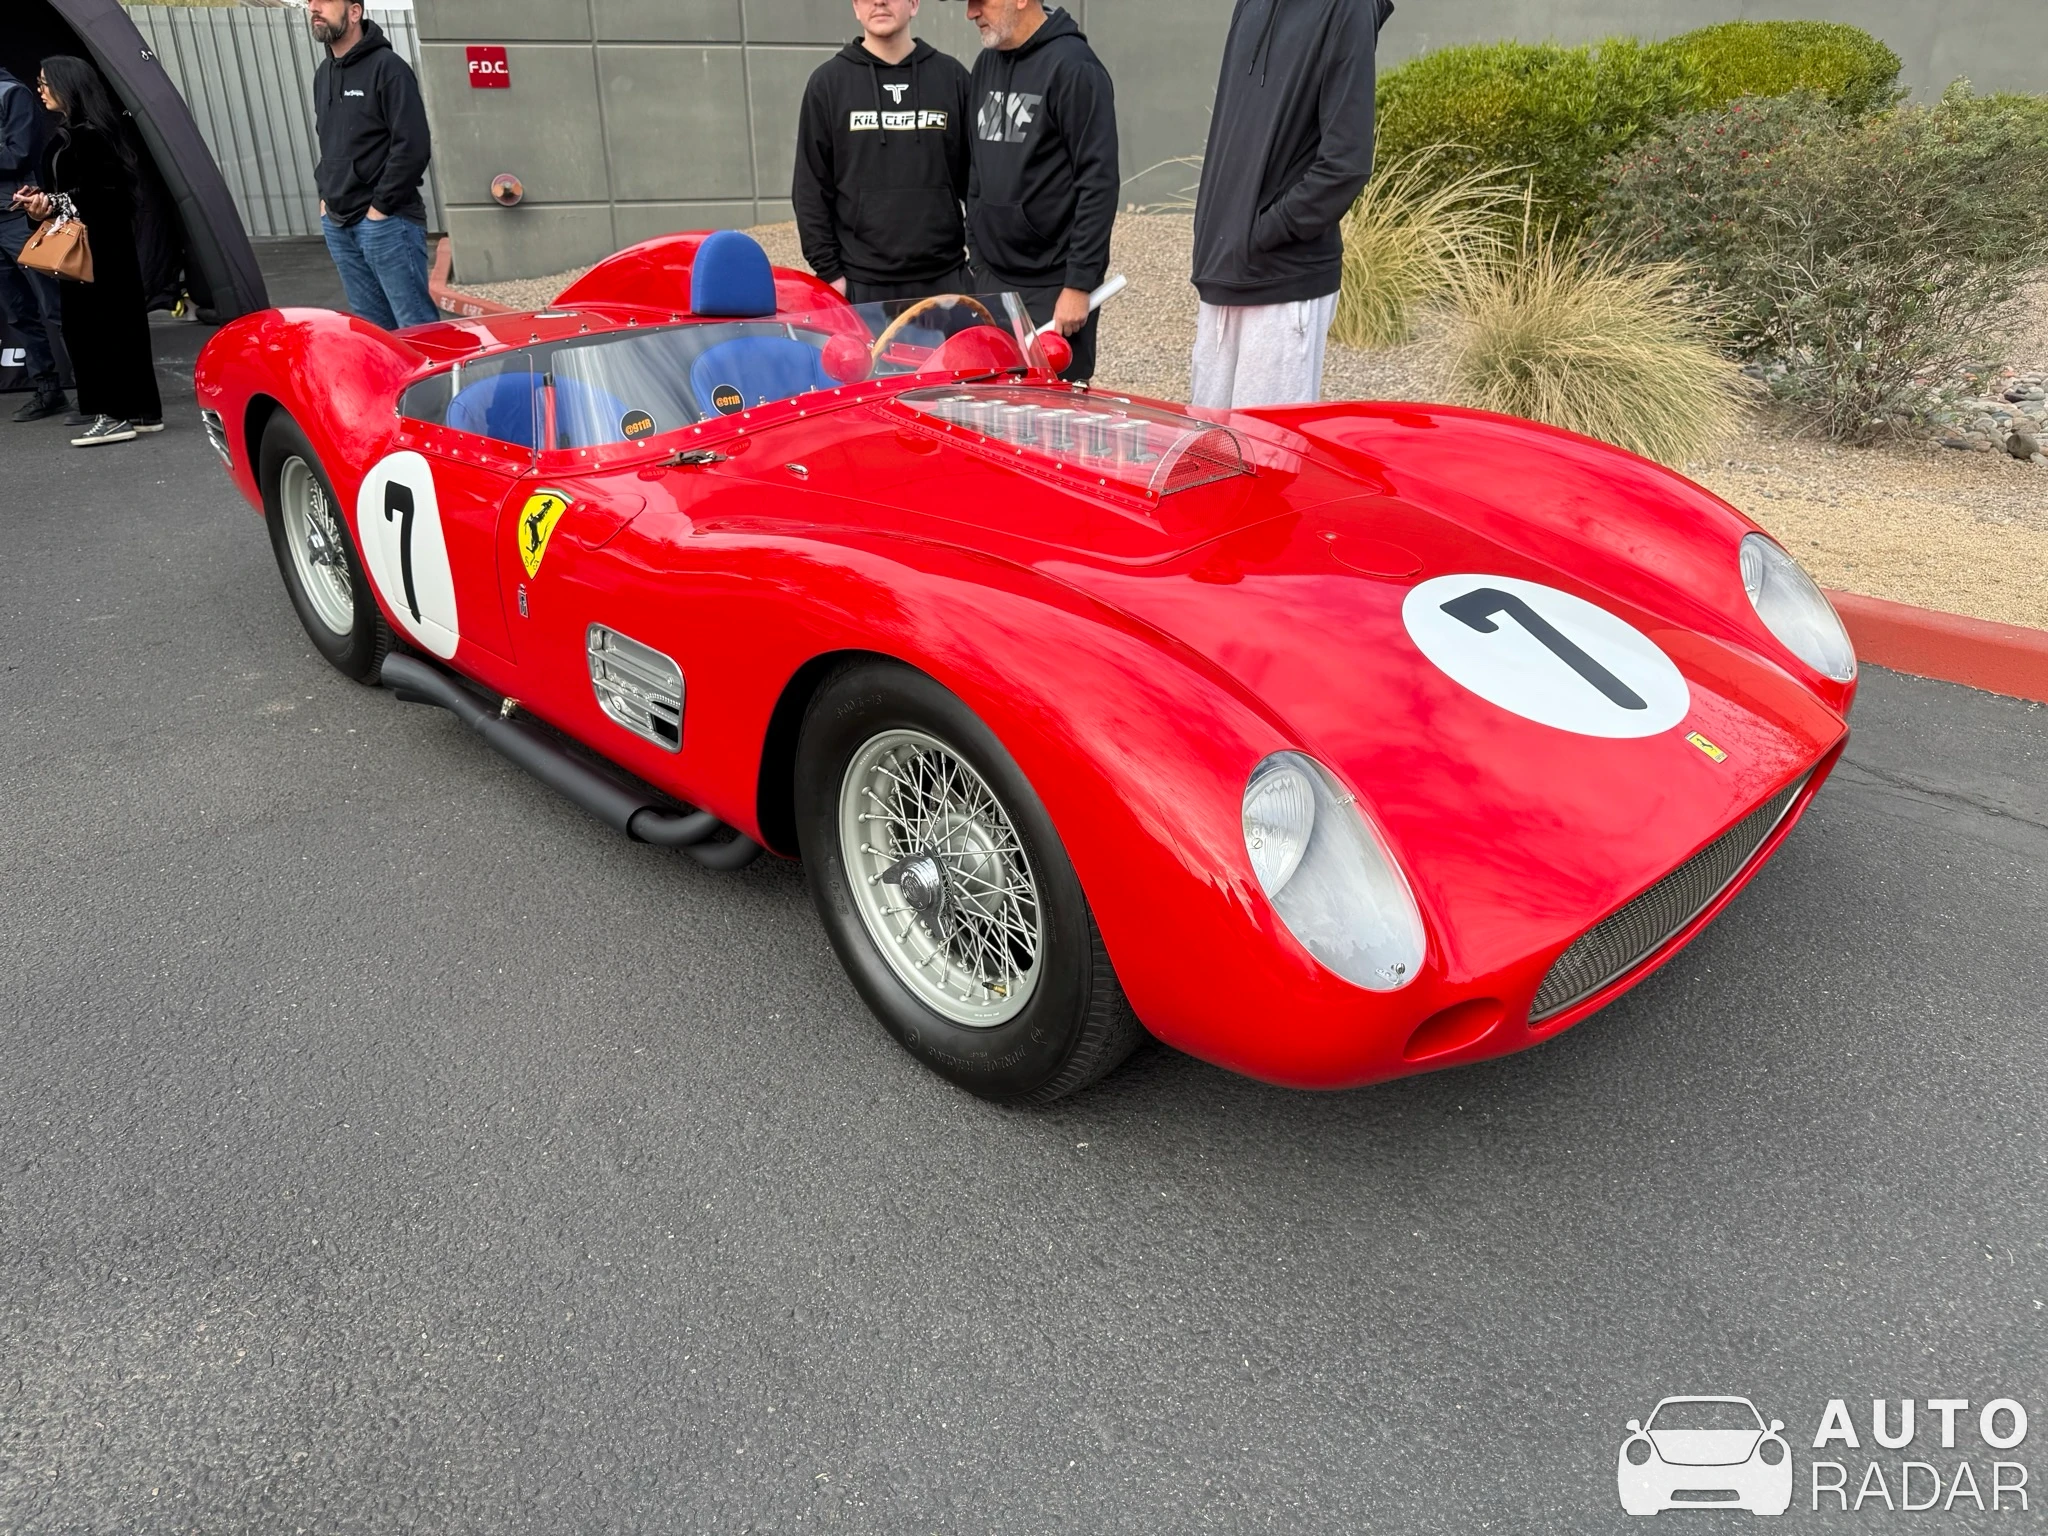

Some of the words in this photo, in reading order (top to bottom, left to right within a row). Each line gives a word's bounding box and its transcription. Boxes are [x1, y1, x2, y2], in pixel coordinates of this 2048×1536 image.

[468, 60, 509, 74] F.D.C.
[853, 114, 880, 126] KIL
[927, 112, 946, 126] FC
[715, 395, 741, 408] @911R
[625, 418, 652, 436] @911R
[384, 480, 422, 624] 7
[1439, 587, 1648, 710] 7
